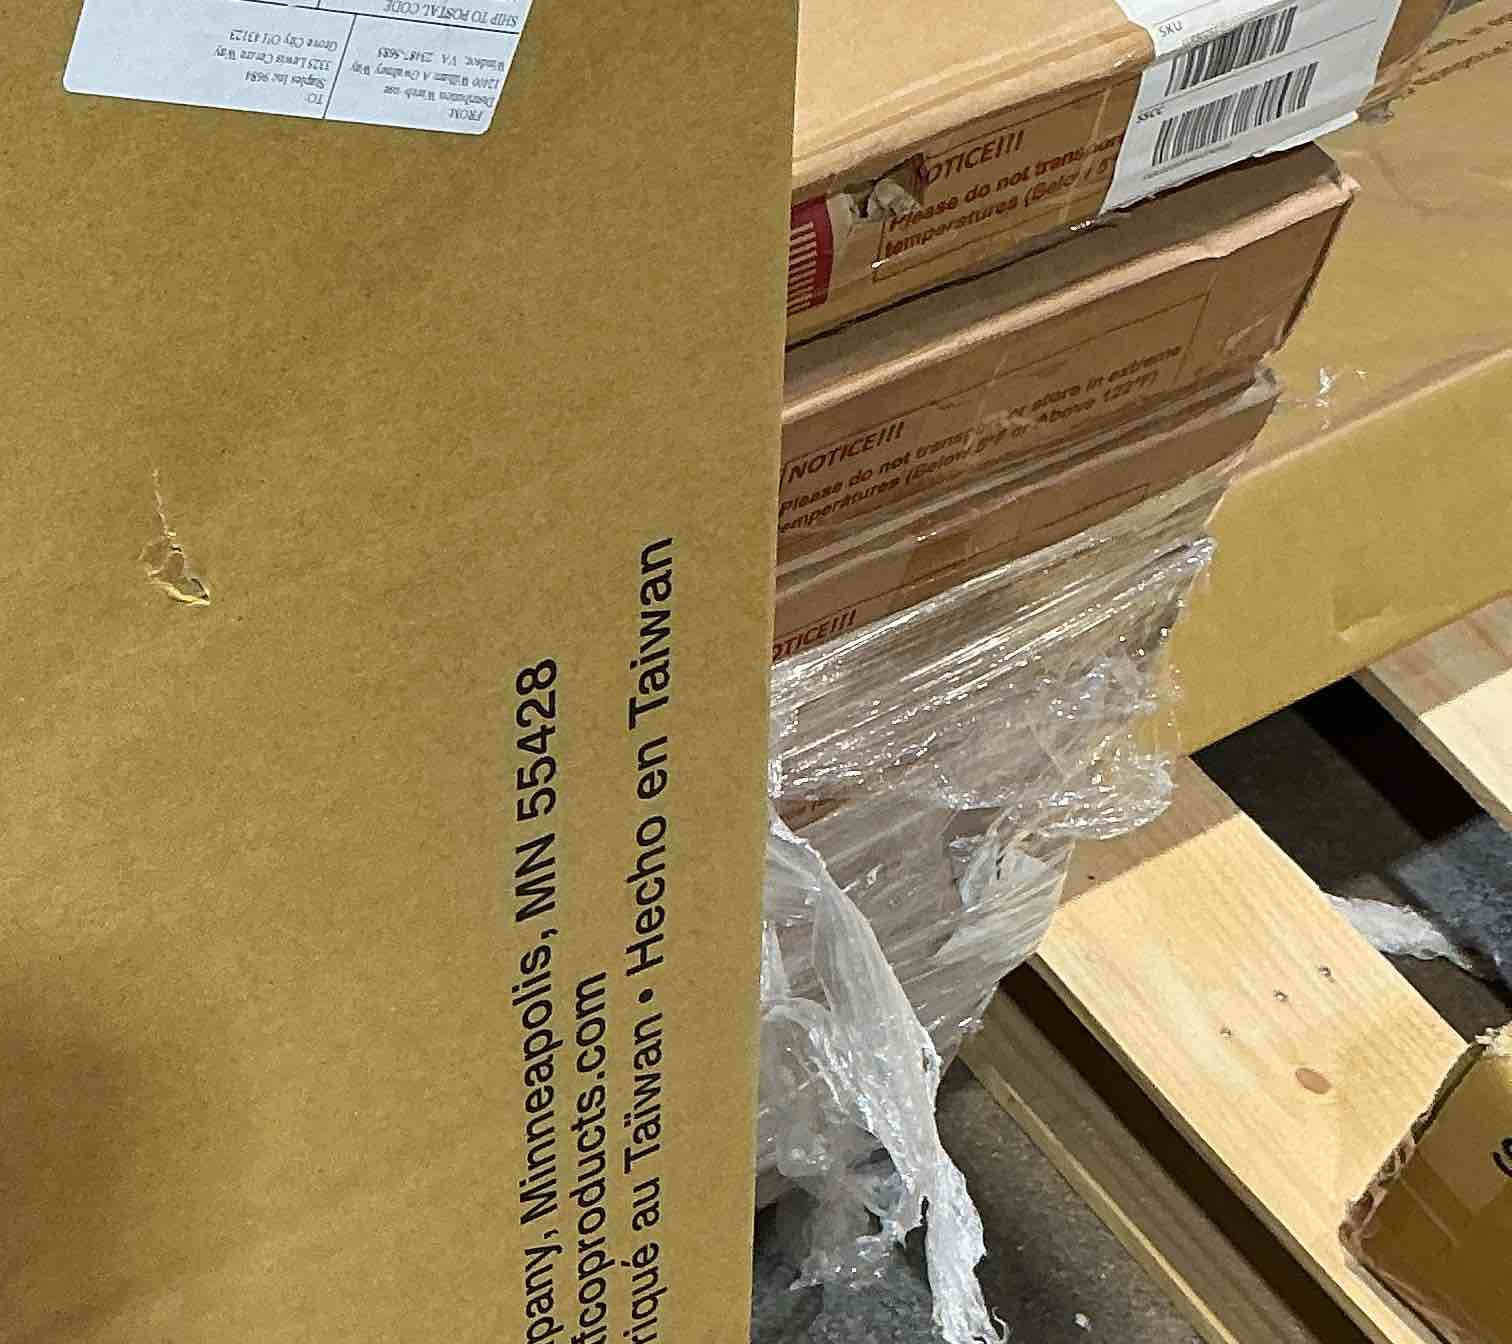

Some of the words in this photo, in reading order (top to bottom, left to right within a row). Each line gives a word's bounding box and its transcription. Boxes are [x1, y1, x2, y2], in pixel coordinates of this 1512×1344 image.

[419, 2, 471, 22] POSTAL
[469, 9, 490, 24] TO
[489, 11, 520, 28] SHIP
[1159, 21, 1184, 38] SKU
[924, 130, 1025, 187] OTICE!!!
[965, 181, 992, 202] do
[996, 162, 1031, 191] not
[779, 480, 844, 516] Please
[848, 469, 873, 489] do
[879, 447, 911, 476] not
[787, 421, 906, 483] NOTICE!!!
[627, 535, 675, 730] Taiwan
[772, 609, 857, 658] OTICE!!!
[513, 656, 558, 818] 55428
[637, 731, 671, 798] en
[513, 829, 559, 920] MN
[623, 813, 669, 977] Hecho
[511, 925, 563, 1224] Minneapolis,
[623, 1010, 665, 1174] Taïwan
[629, 1175, 661, 1231] au
